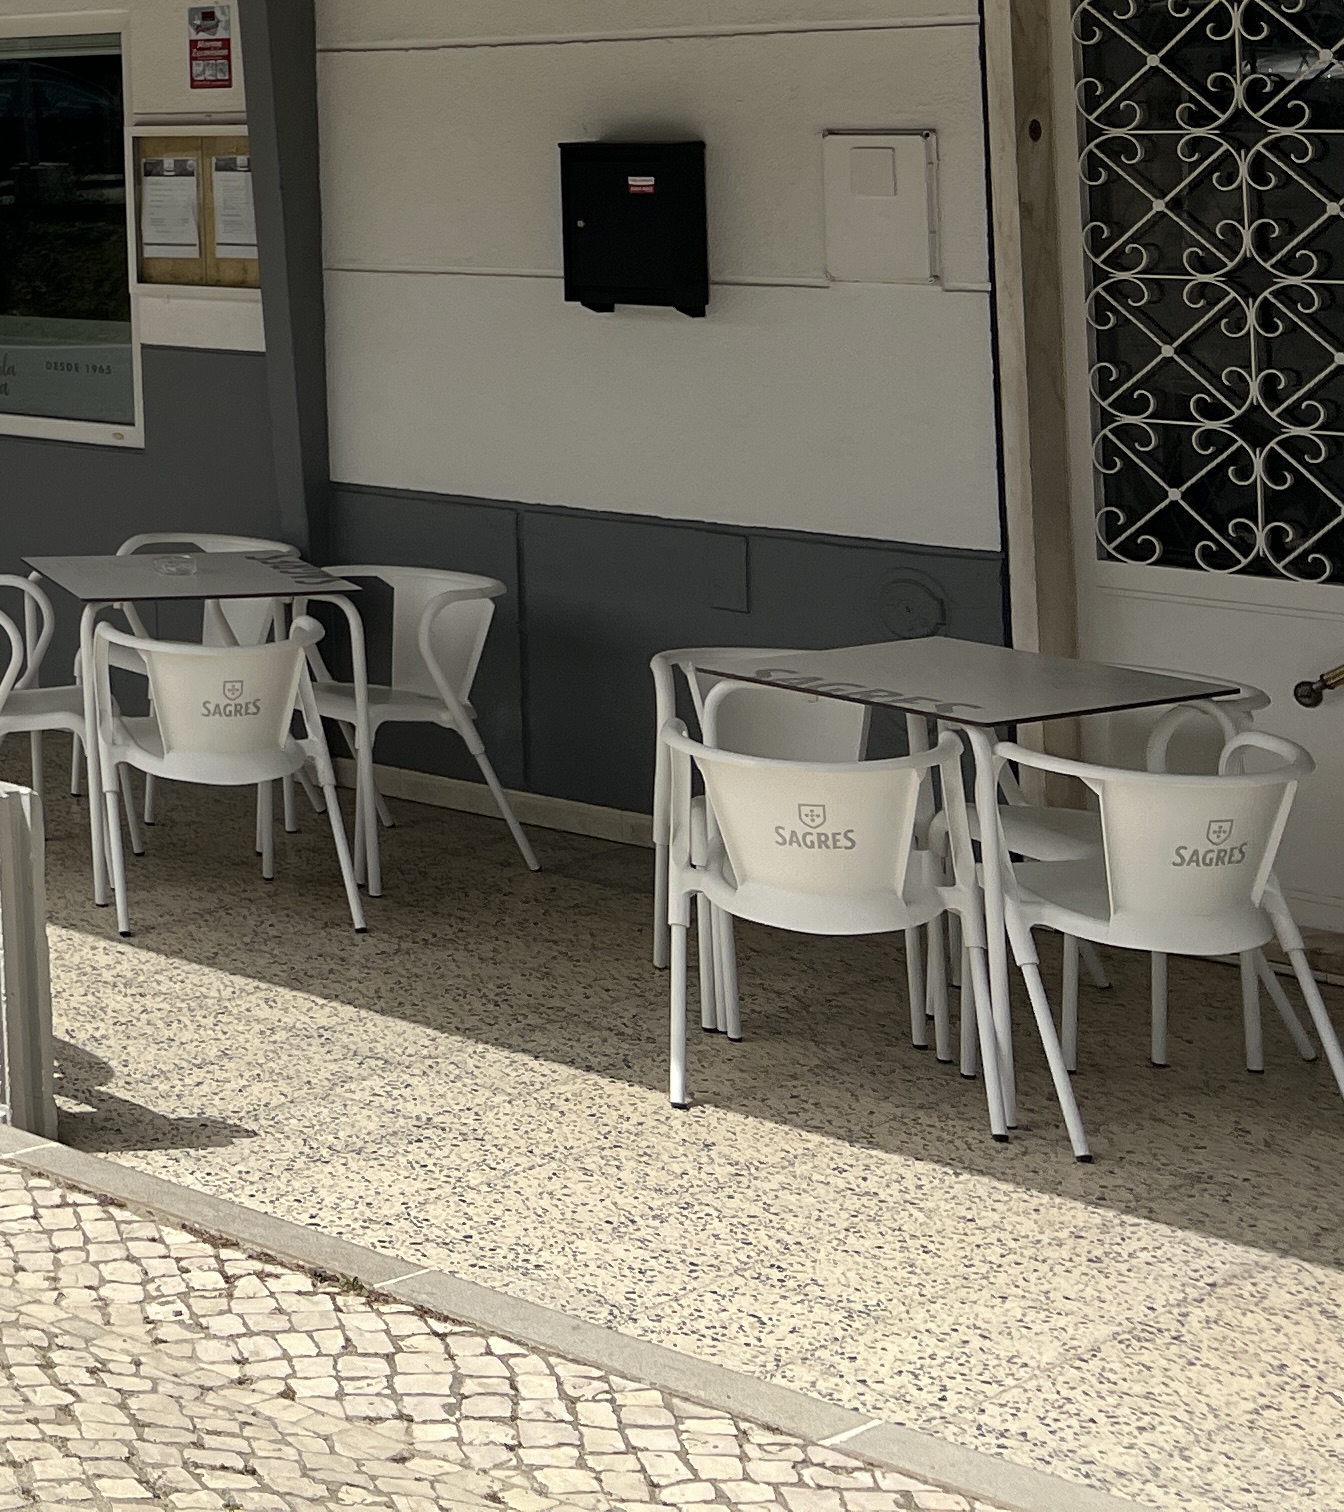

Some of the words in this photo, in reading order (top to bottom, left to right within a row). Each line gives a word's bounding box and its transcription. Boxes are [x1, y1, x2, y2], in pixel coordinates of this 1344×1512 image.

[45, 360, 80, 373] DESDE
[84, 363, 112, 375] 1965
[201, 698, 261, 717] SAGRES
[774, 825, 857, 850] SAGRES
[1172, 842, 1248, 867] SAGRES
